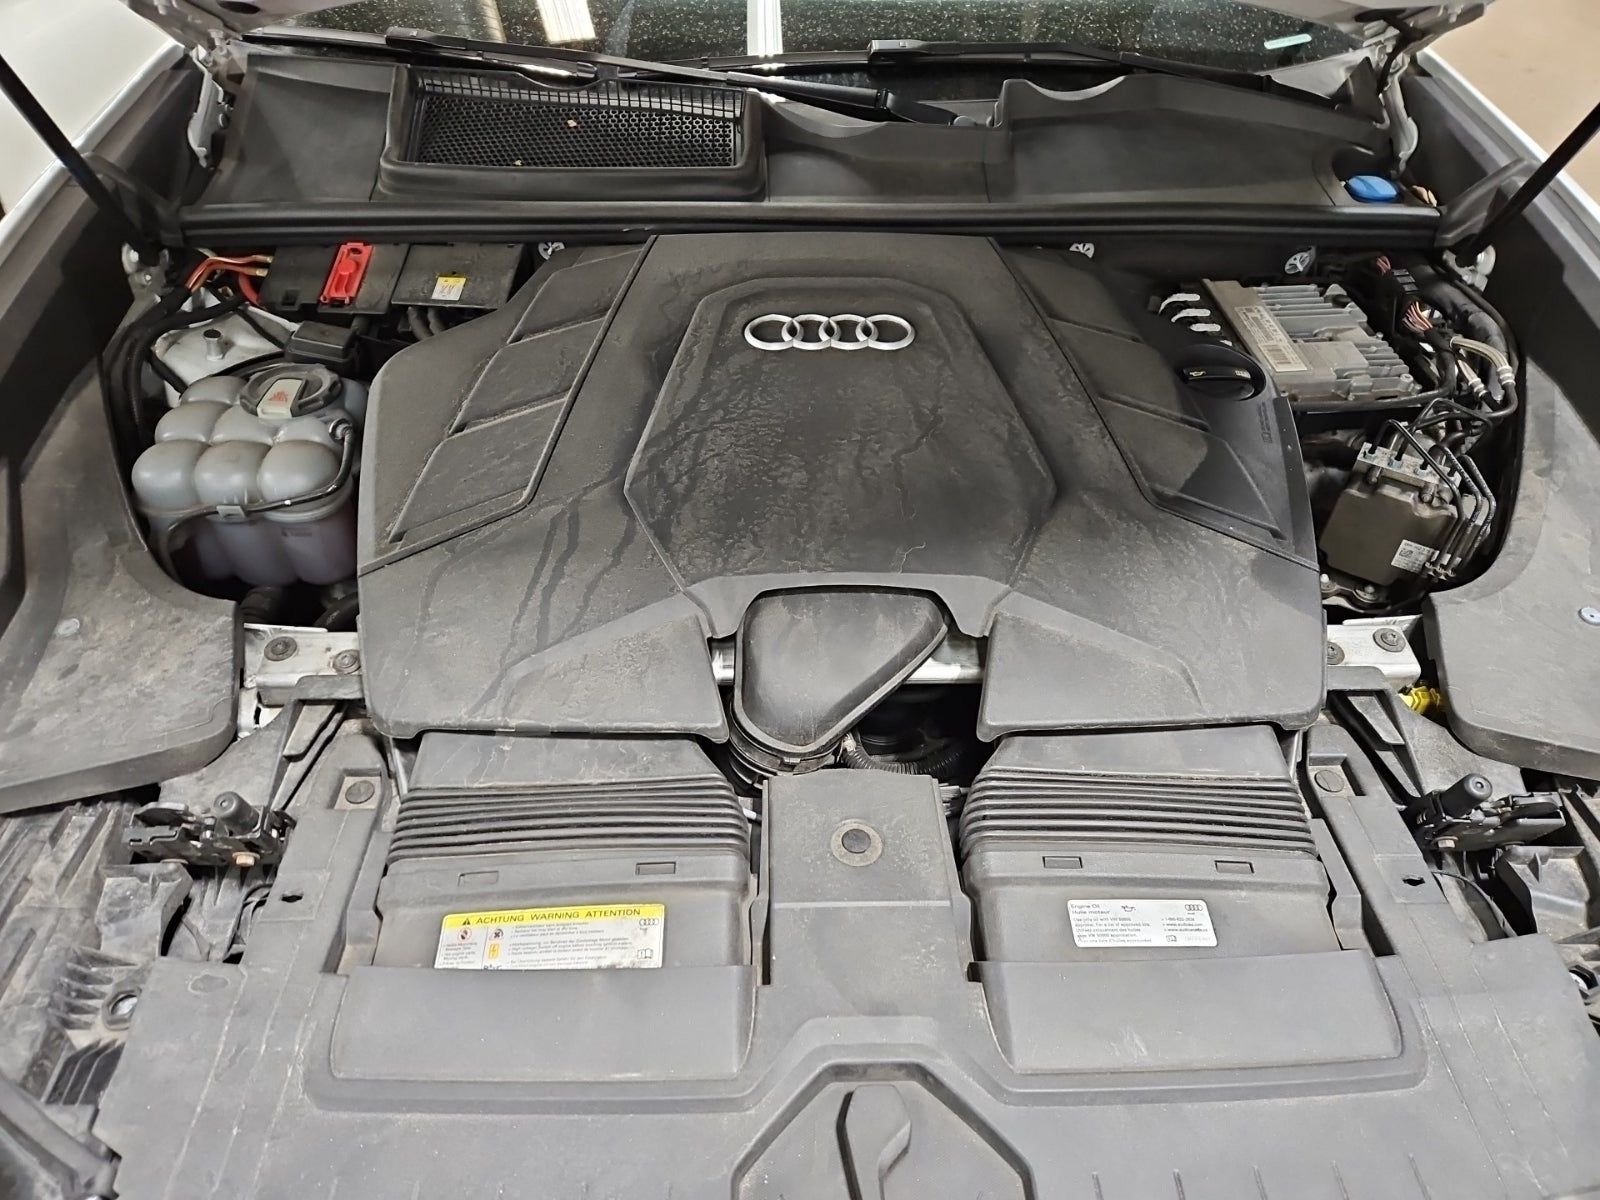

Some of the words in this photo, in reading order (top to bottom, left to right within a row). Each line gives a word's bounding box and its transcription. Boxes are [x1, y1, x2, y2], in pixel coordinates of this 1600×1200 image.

[476, 915, 525, 925] ACHTUNG
[530, 911, 580, 921] WARNING
[584, 908, 641, 918] ATTENTION
